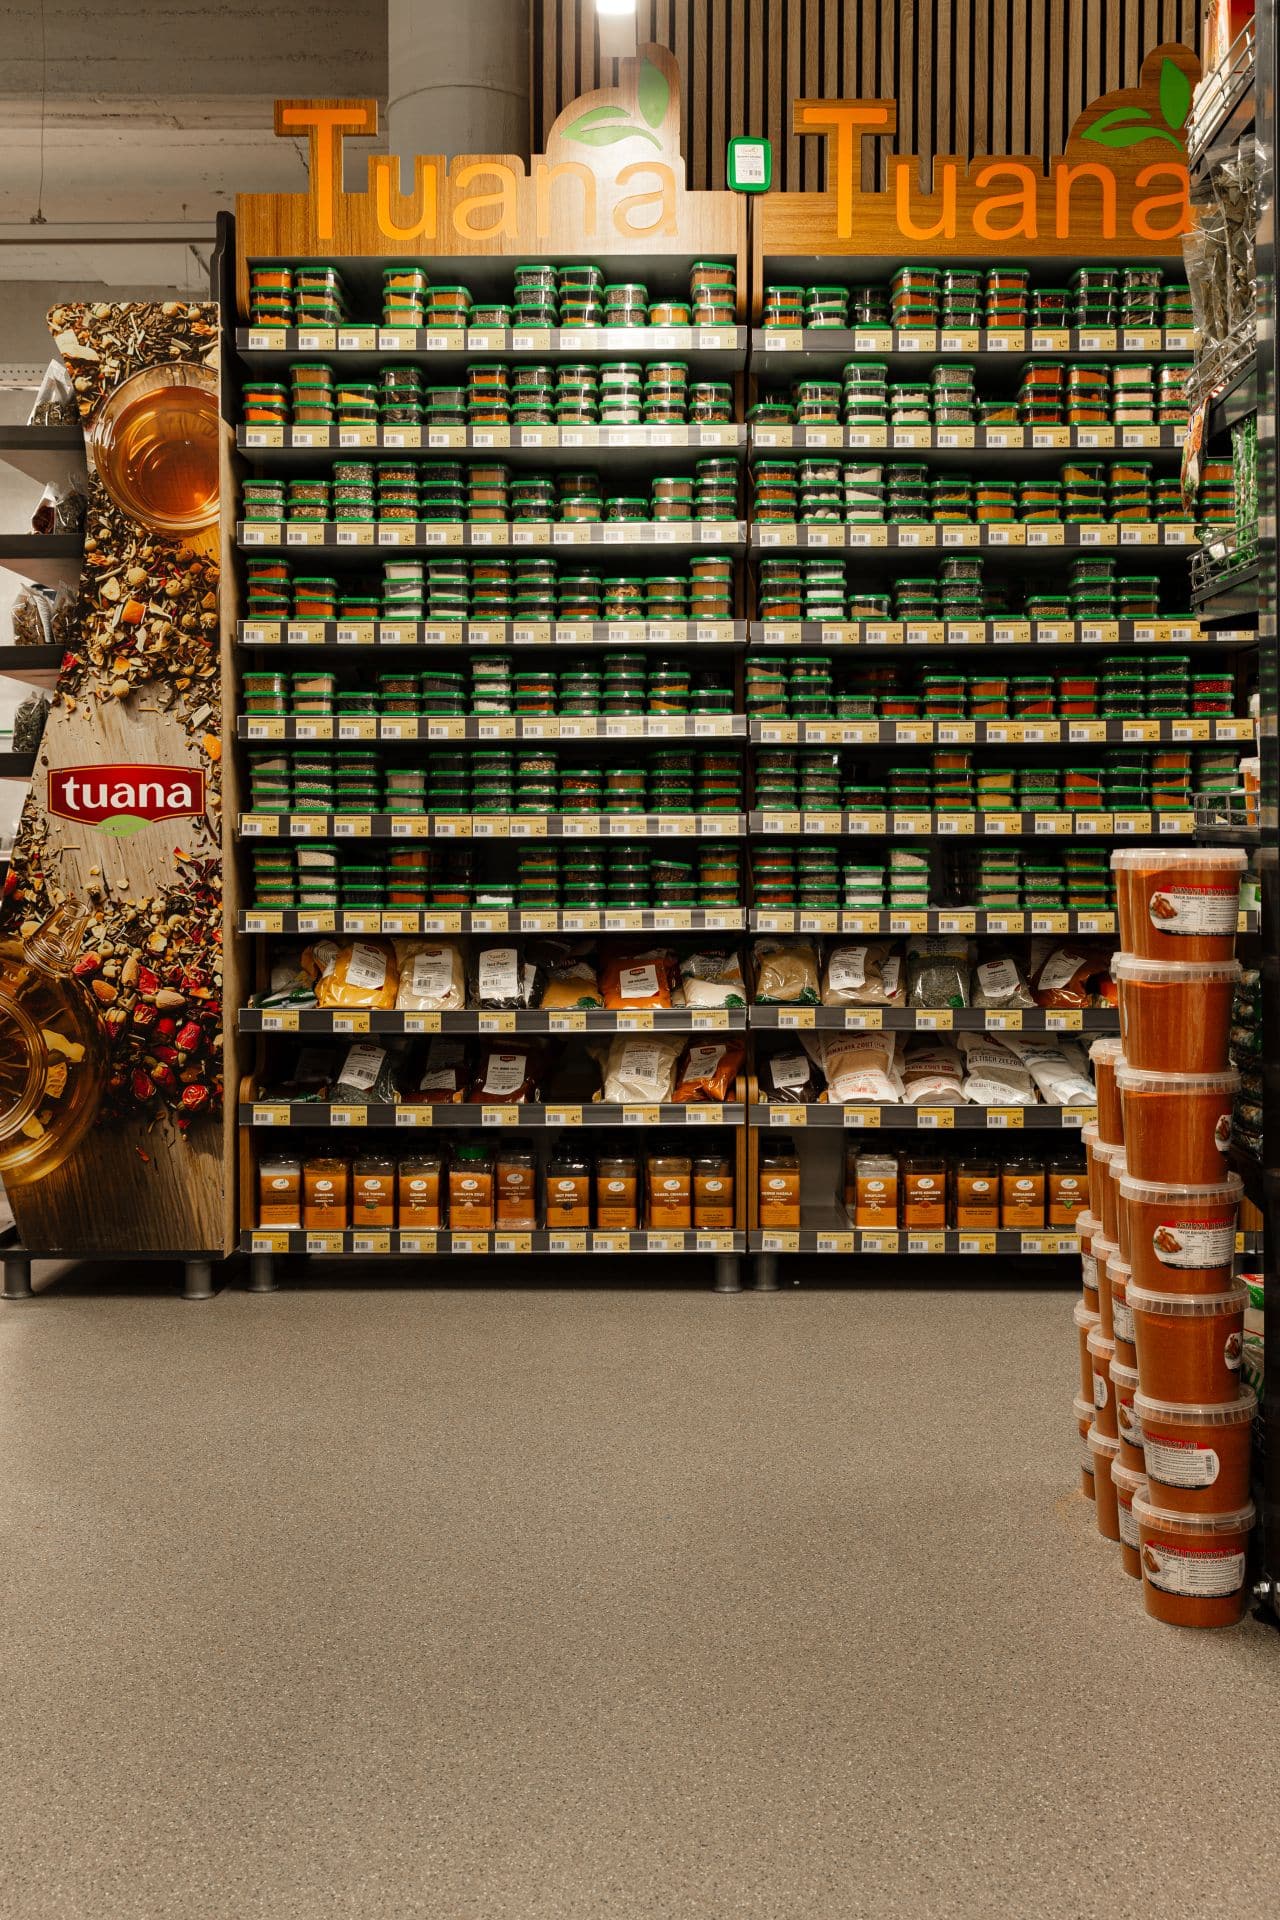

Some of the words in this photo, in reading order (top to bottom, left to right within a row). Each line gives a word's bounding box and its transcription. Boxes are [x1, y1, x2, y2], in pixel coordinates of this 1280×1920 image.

[283, 107, 679, 241] Tuana
[803, 107, 1192, 241] Tuana
[61, 776, 192, 811] tuana
